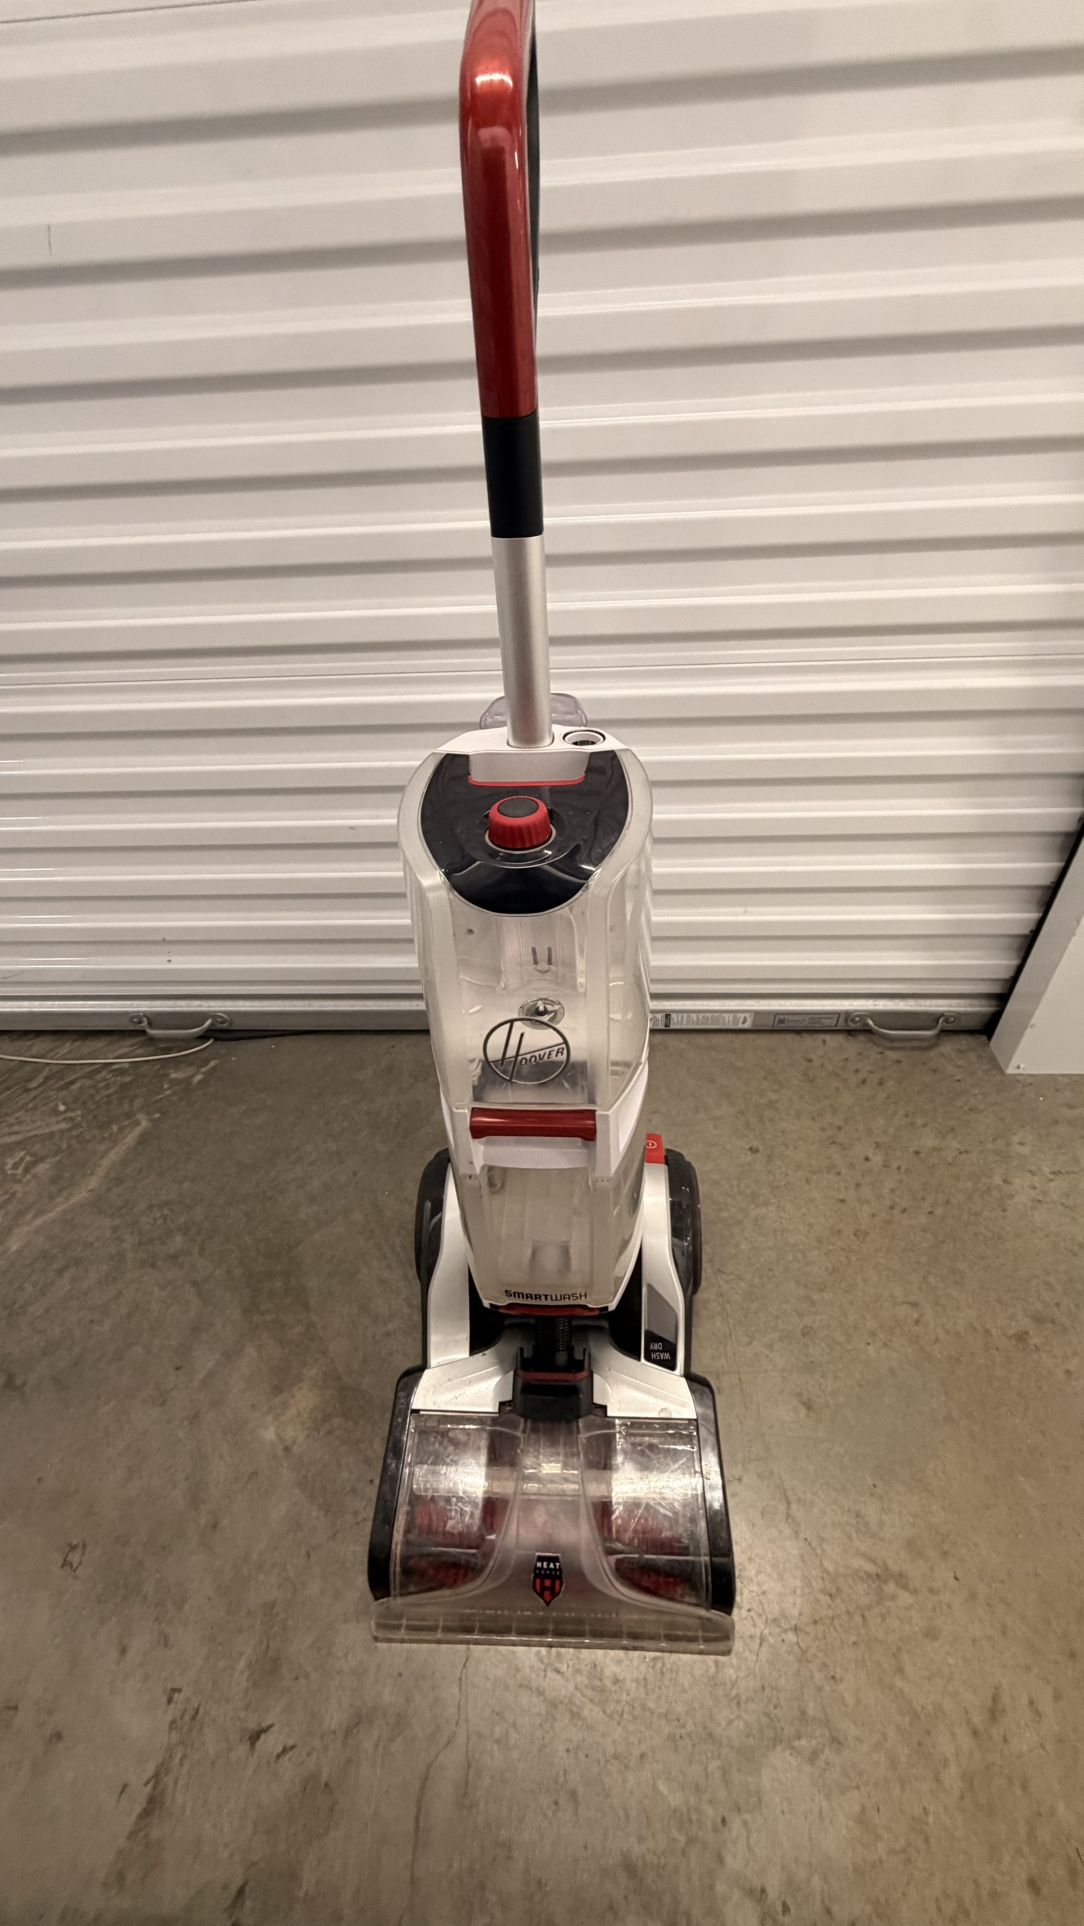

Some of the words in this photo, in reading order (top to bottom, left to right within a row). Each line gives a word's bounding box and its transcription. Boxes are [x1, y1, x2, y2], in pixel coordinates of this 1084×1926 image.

[499, 1020, 565, 1081] HOOVER
[504, 1289, 588, 1302] SMARTWASH
[649, 1342, 663, 1350] DRY
[651, 1351, 671, 1360] WASH
[536, 1561, 560, 1569] HEAT
